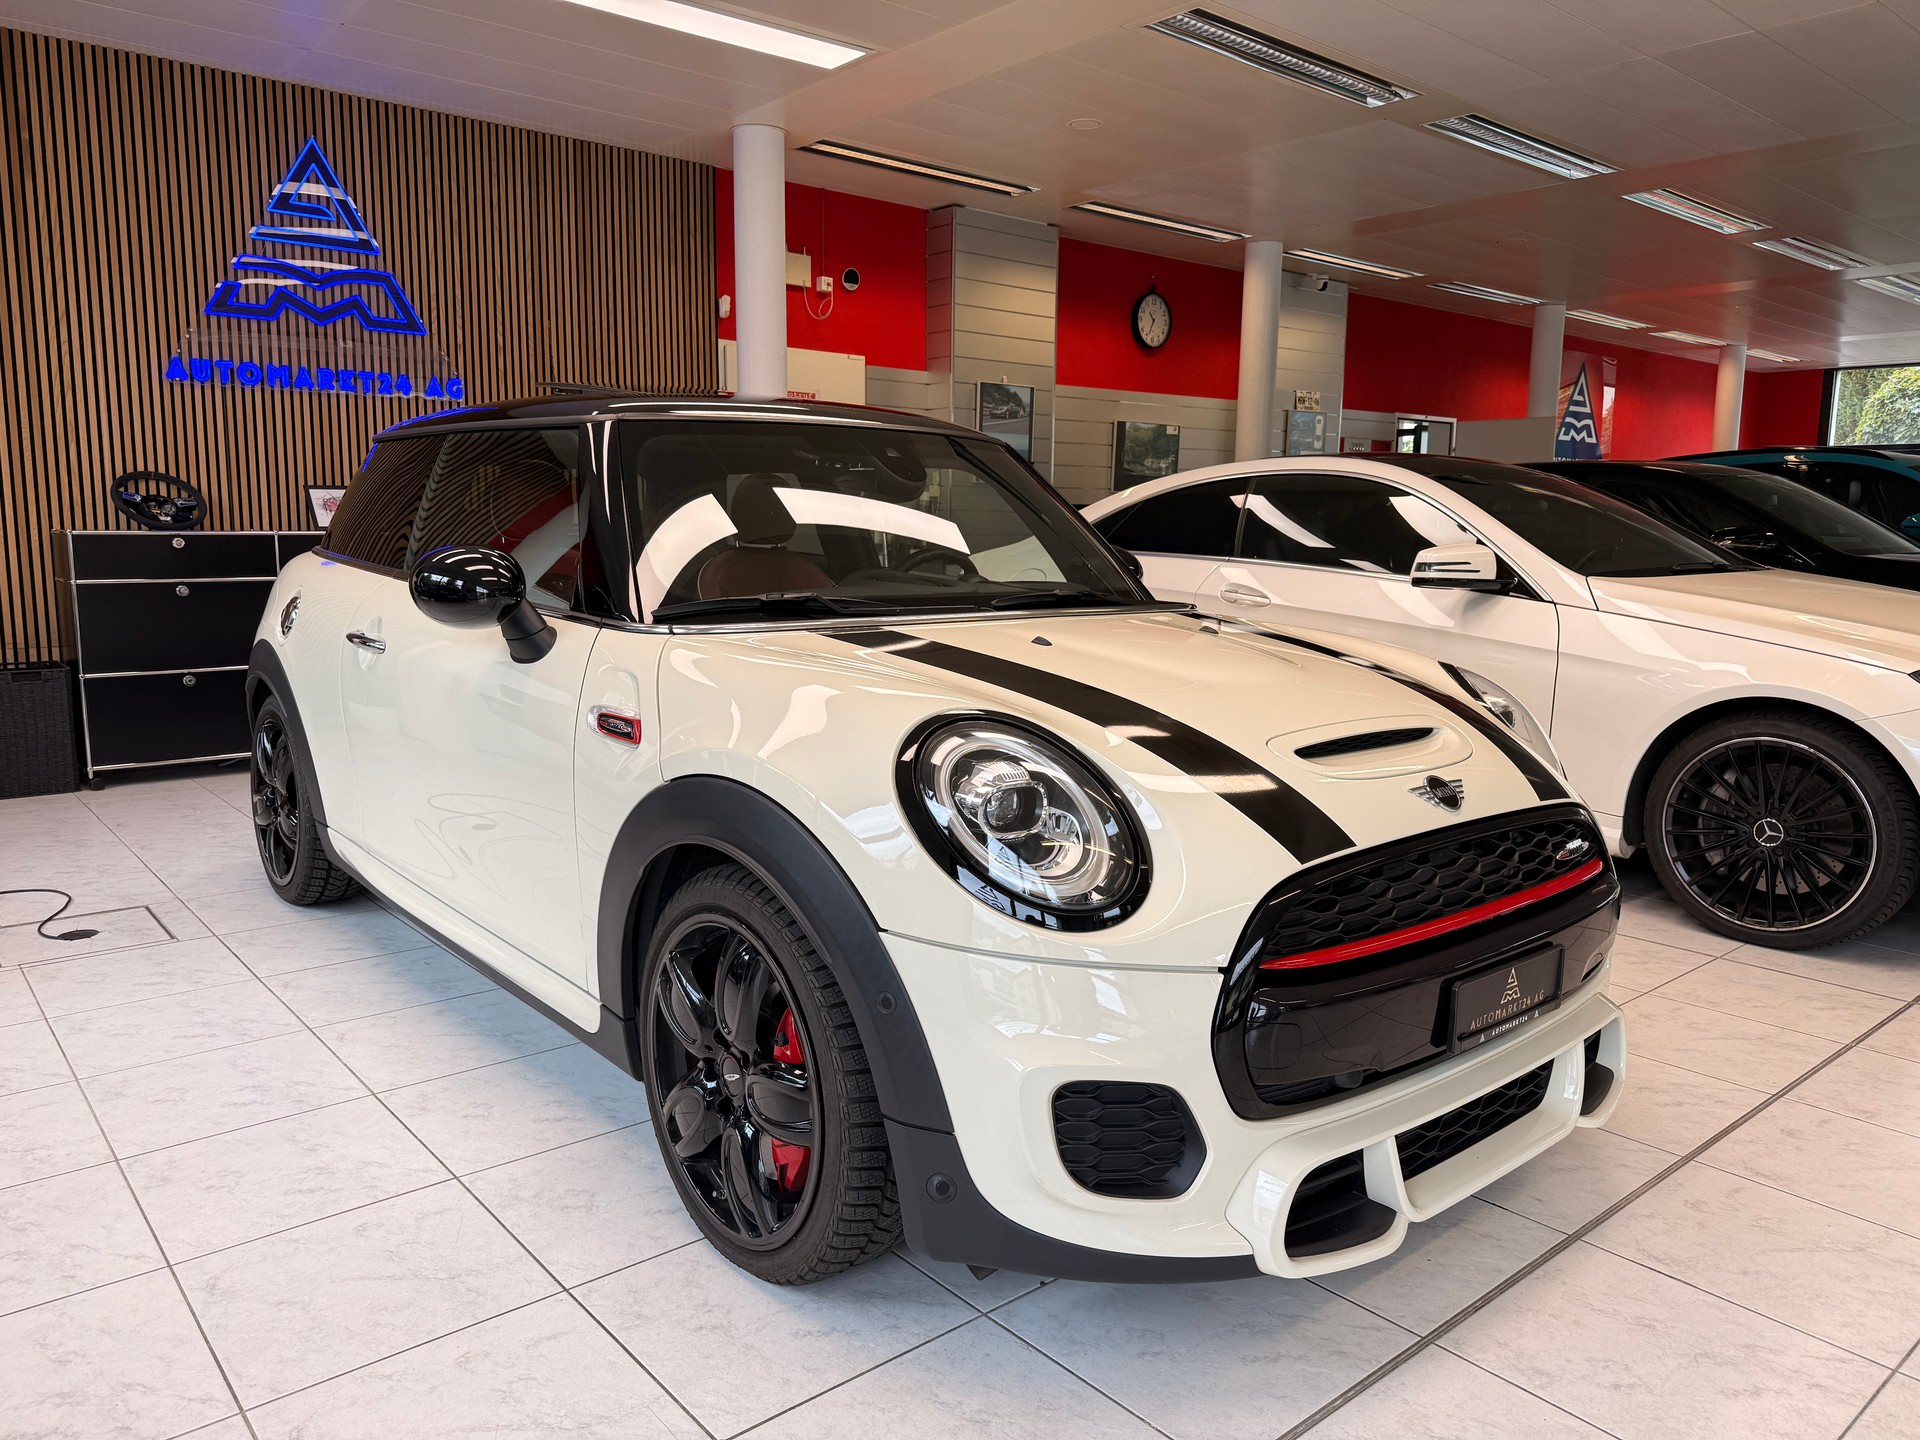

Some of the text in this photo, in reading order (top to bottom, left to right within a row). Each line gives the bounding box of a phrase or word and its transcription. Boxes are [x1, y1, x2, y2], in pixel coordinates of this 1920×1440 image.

[165, 355, 464, 401] AUTOMARKT24 AG
[788, 391, 814, 399] otruf
[1431, 786, 1456, 798] MINI
[1470, 990, 1545, 1030] AUTOMARKT24 AG
[1491, 1015, 1528, 1036] AUTOMARKT24
